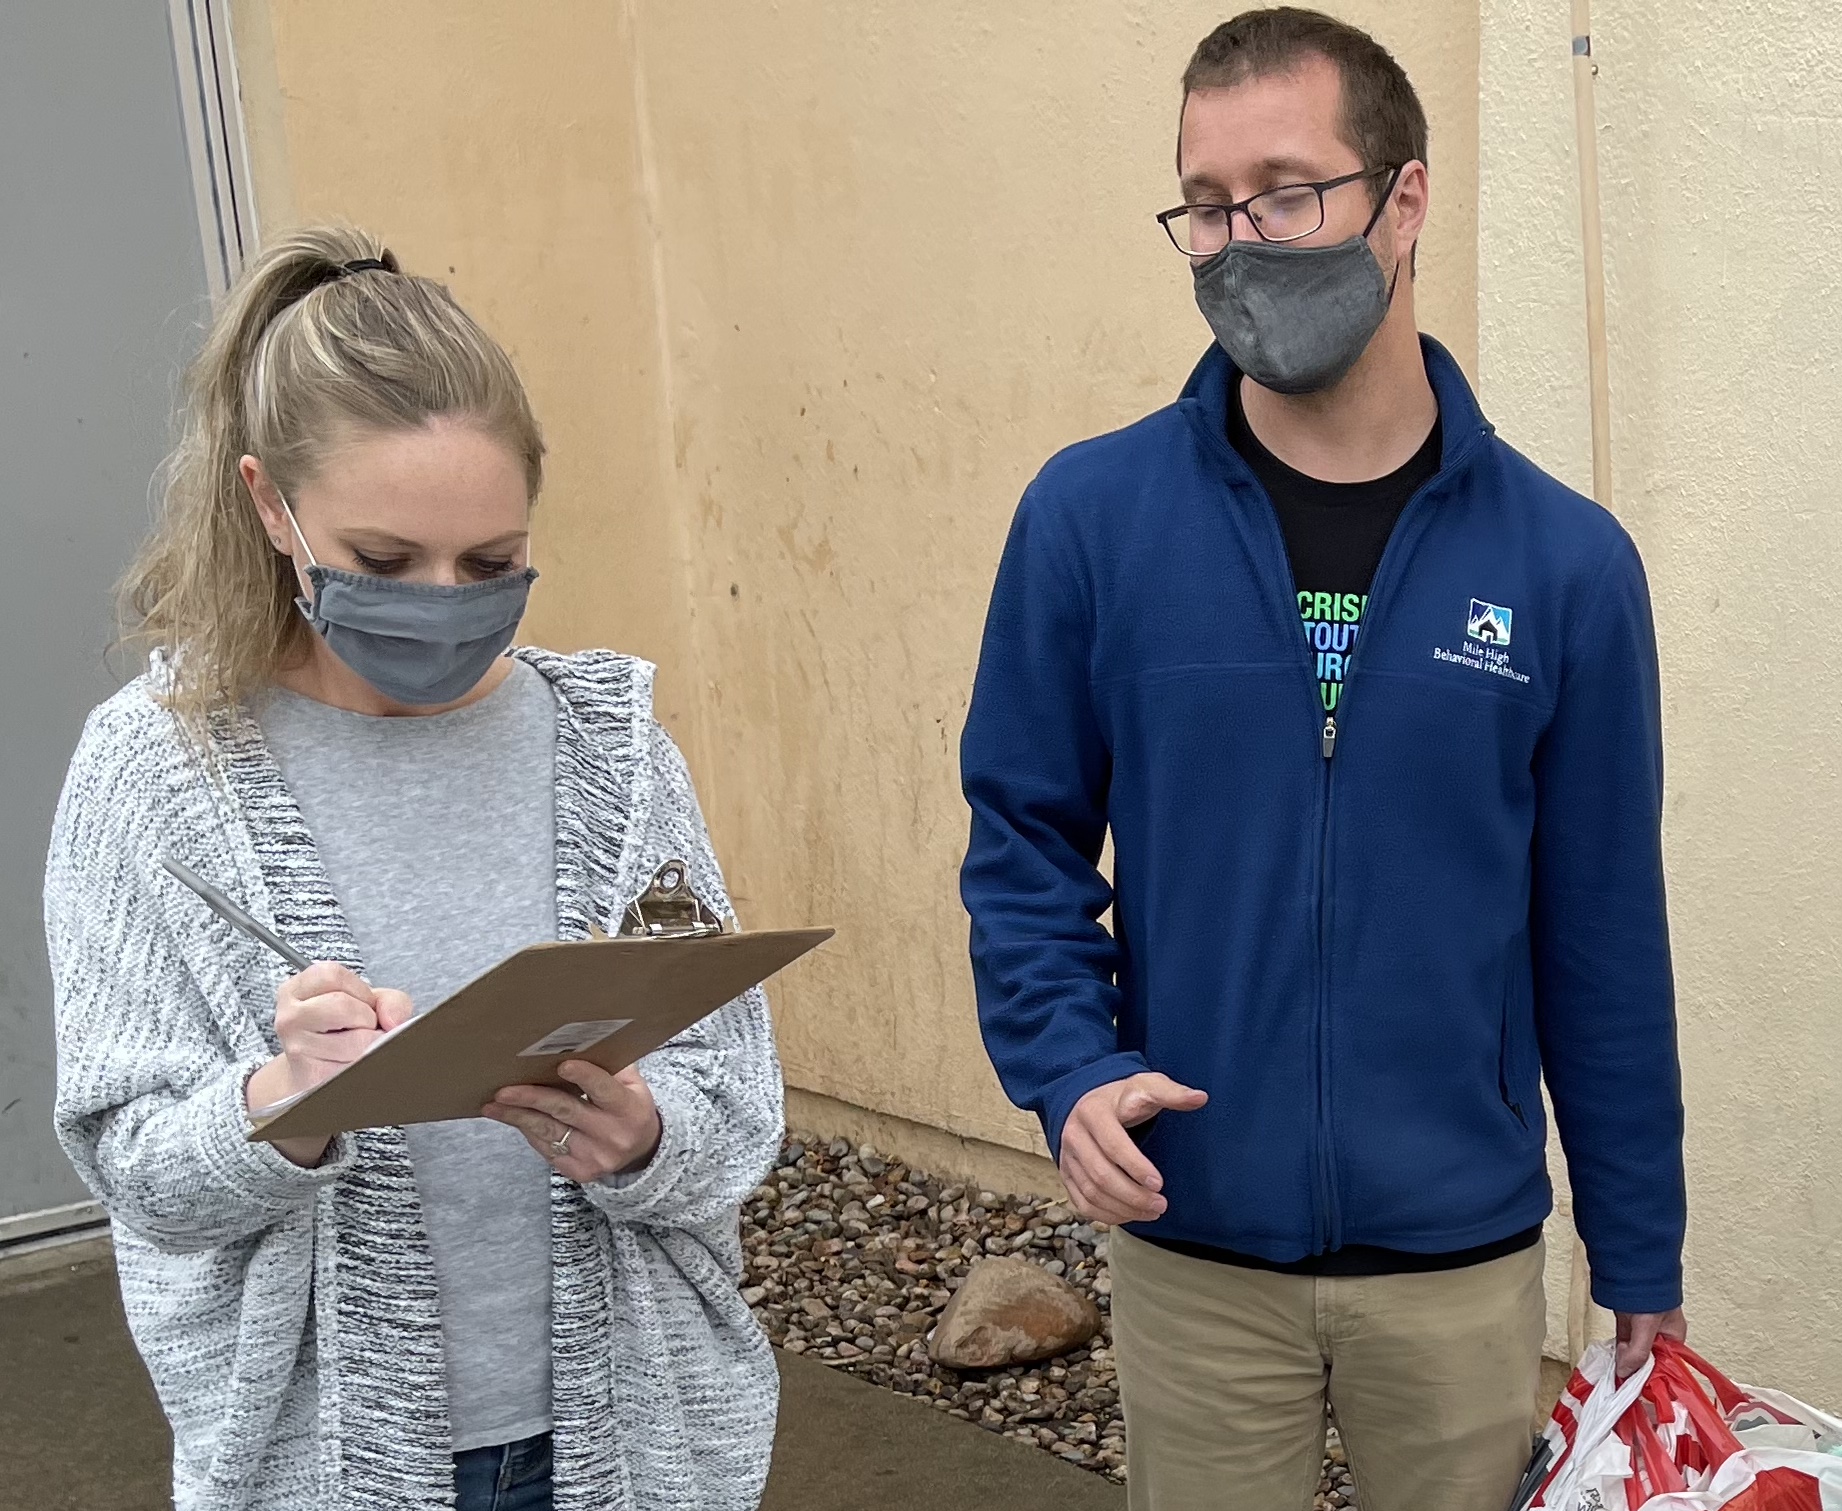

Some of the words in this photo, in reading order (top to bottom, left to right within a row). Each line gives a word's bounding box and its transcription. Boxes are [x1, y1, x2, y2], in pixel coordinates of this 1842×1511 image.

[1433, 647, 1483, 670] Behavioral
[1483, 660, 1531, 684] Healthcare
[1462, 640, 1485, 657] Mile
[1485, 647, 1510, 666] High
